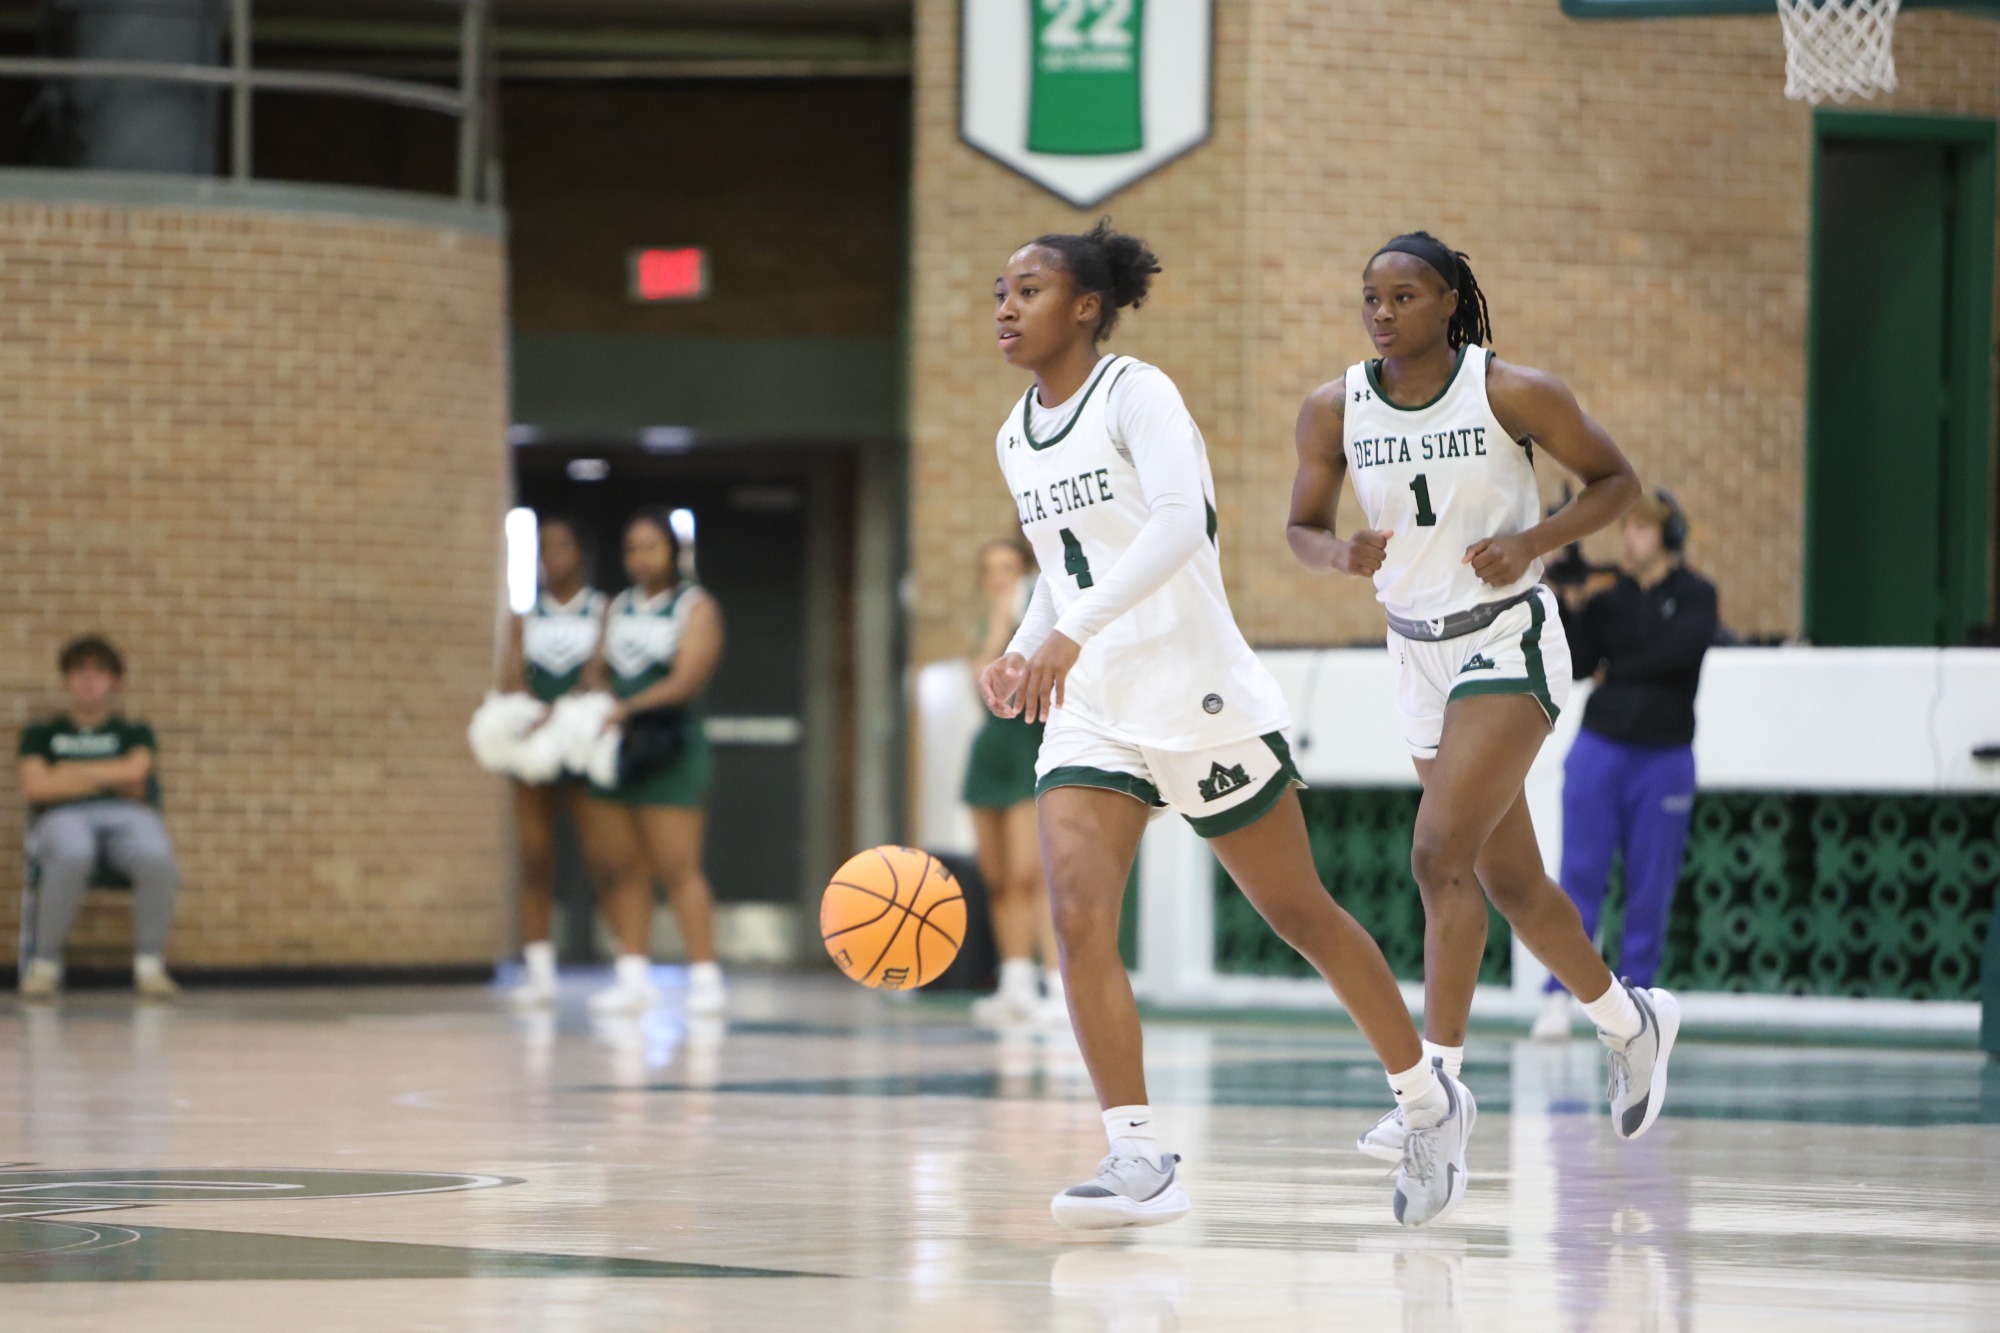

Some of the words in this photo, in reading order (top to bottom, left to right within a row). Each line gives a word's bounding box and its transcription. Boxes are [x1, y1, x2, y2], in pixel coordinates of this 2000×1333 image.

[1040, 0, 1133, 47] 22
[1354, 436, 1411, 469] DELTA
[1421, 427, 1486, 460] STATE
[1017, 488, 1047, 525] LTA
[1049, 468, 1114, 515] STATE
[1409, 473, 1436, 526] 1
[1059, 527, 1094, 590] 4
